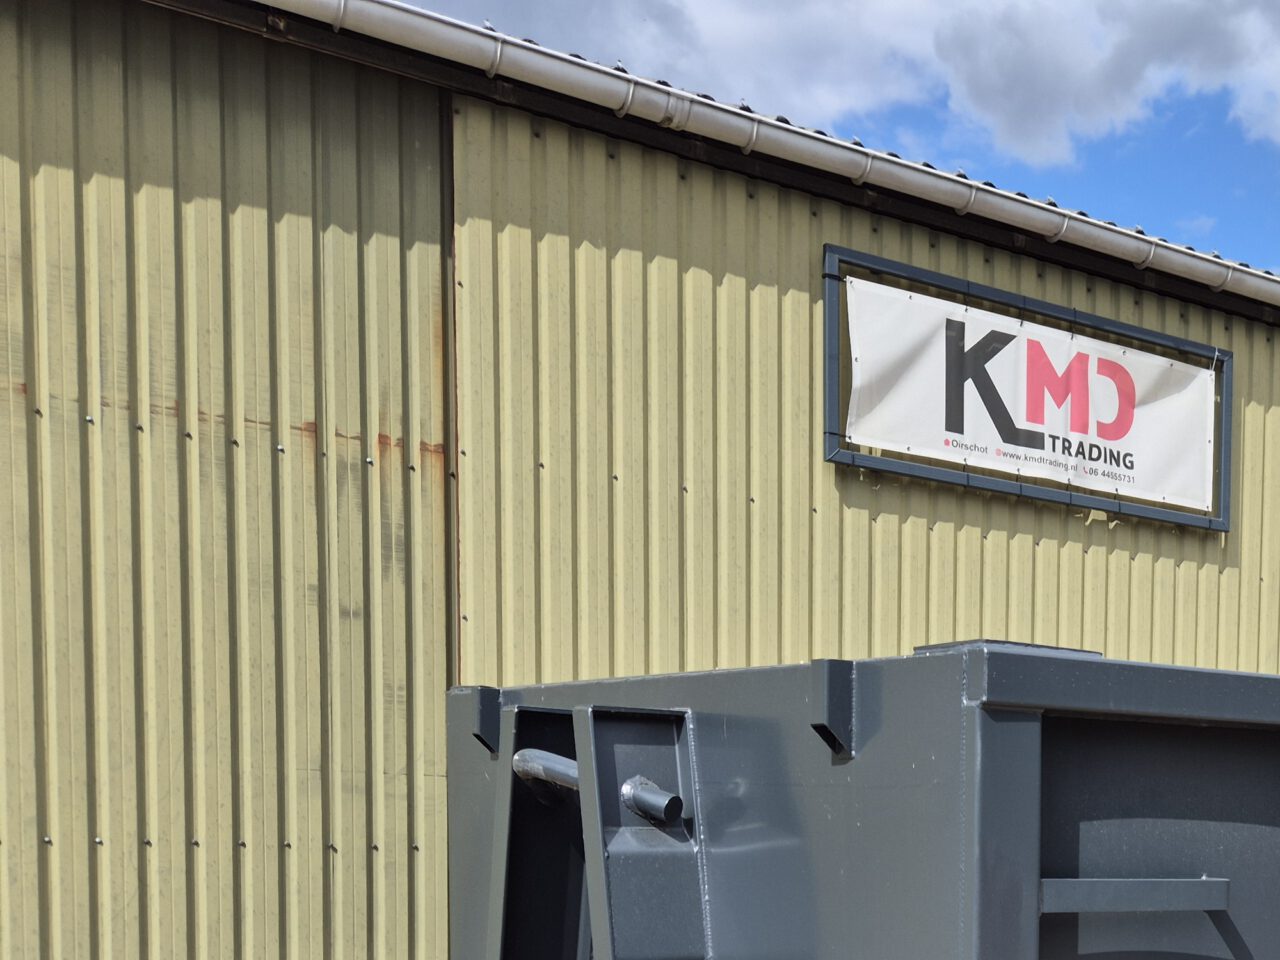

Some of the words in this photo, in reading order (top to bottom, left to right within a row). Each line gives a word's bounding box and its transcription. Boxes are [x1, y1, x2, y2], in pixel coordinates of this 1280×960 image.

[945, 318, 1136, 450] KMD
[951, 439, 988, 454] Oirschot
[1001, 449, 1078, 472] www.kmdtrading.nl
[1088, 467, 1099, 477] 06
[1101, 469, 1135, 484] 44555731
[1048, 434, 1135, 470] TRADING
